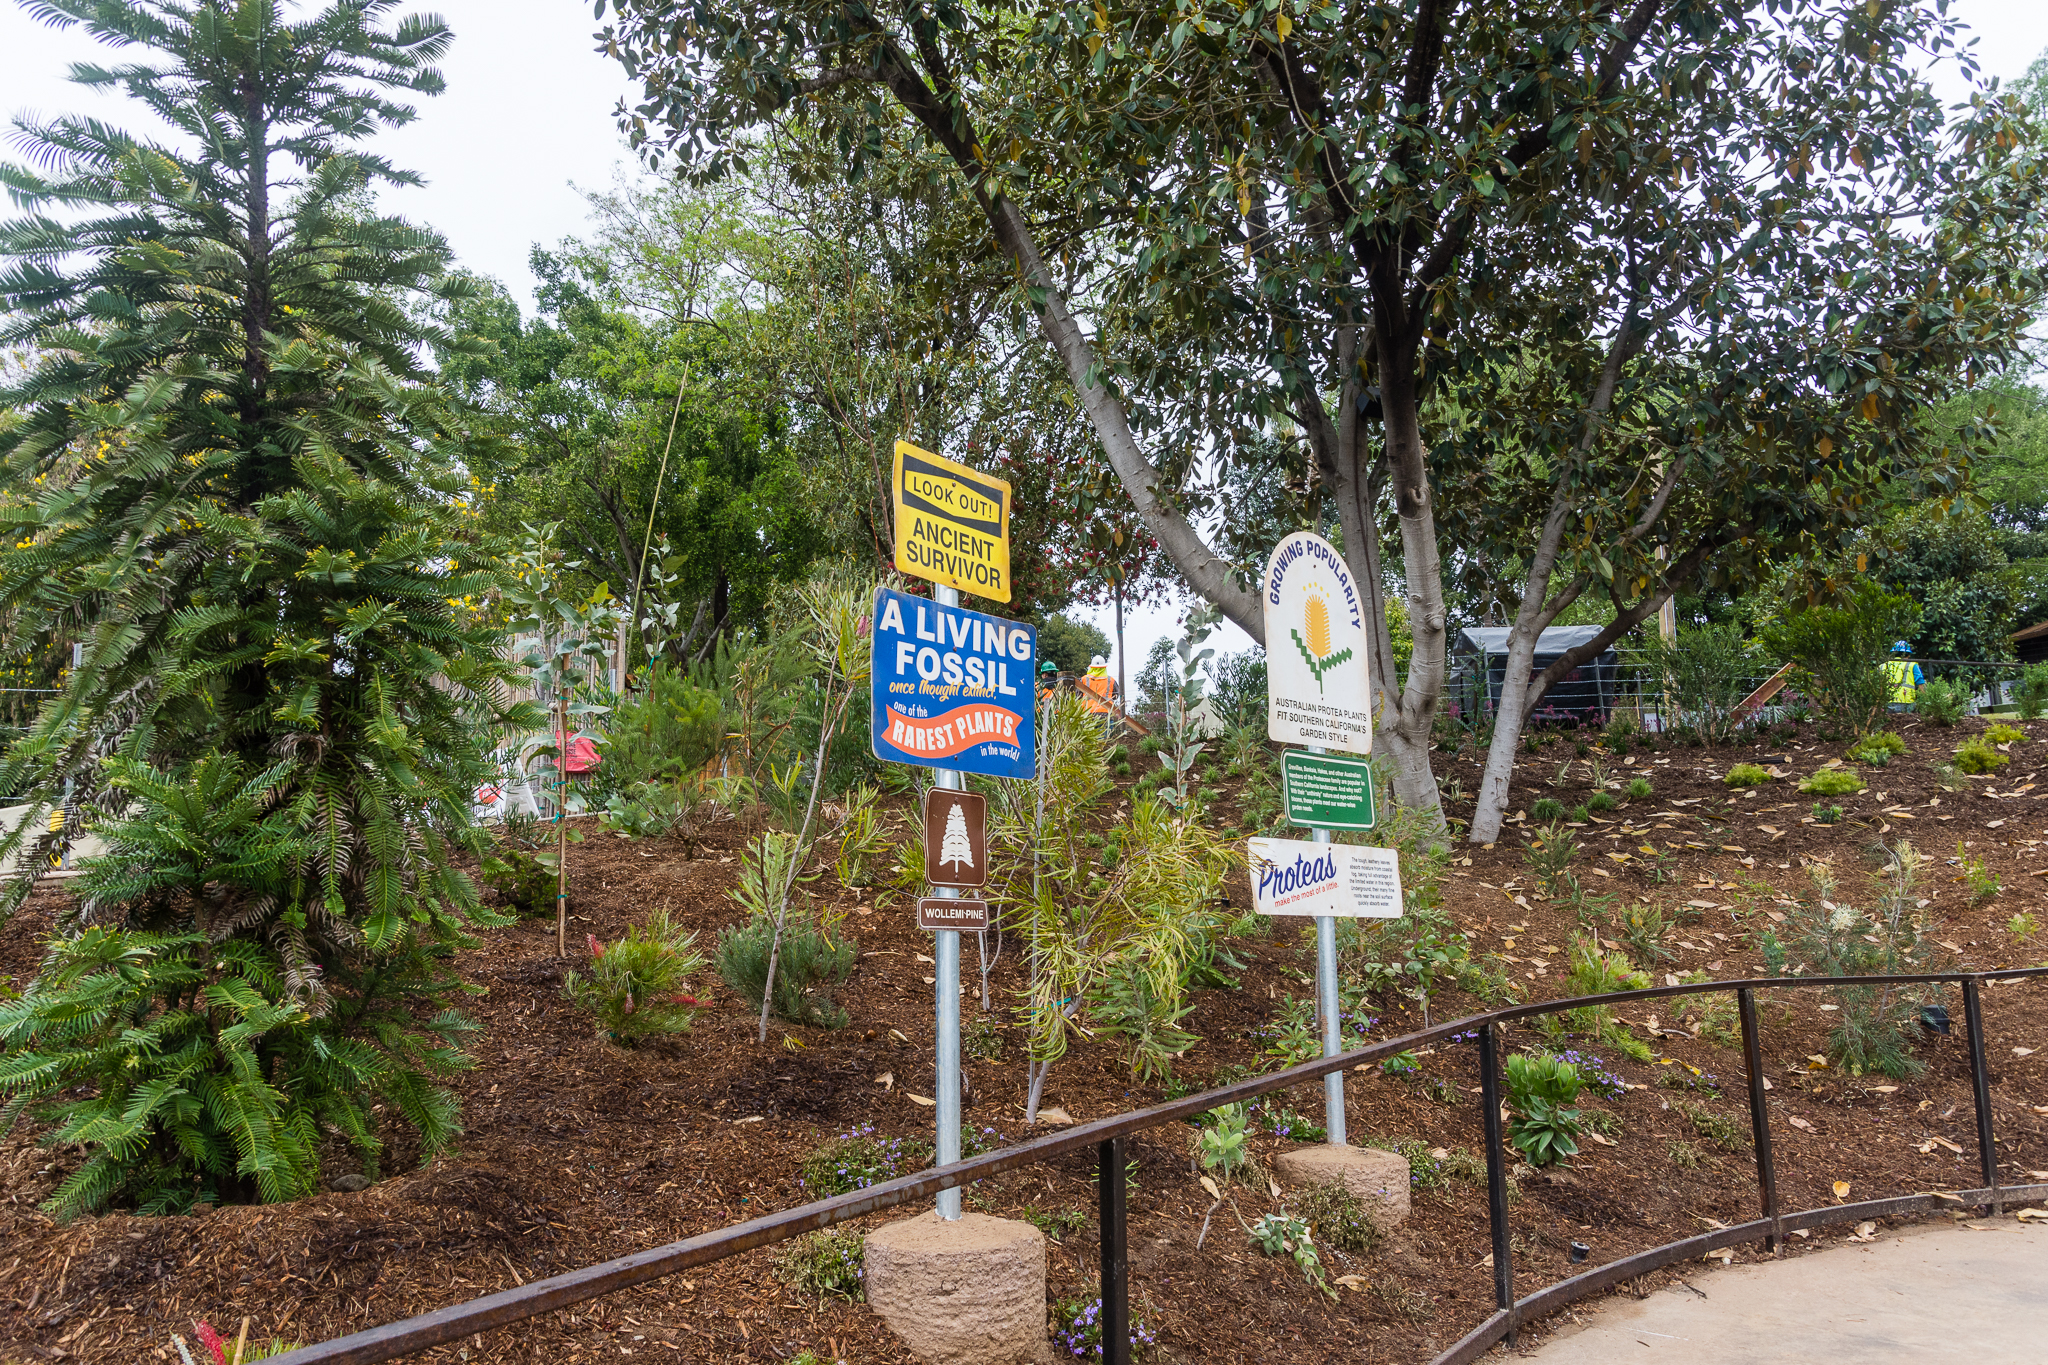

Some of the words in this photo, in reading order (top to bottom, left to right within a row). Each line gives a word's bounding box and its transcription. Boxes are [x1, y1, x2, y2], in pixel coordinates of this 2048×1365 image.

[913, 476, 954, 505] LOOK
[959, 494, 992, 518] OUT!
[913, 517, 994, 562] ANCIENT
[906, 540, 1001, 590] SURVIVOR
[1270, 540, 1304, 606] GROWING
[1306, 540, 1361, 629] POPULARITY
[879, 598, 906, 635] A
[916, 605, 1031, 661] LIVING
[896, 640, 1017, 696] FOSSIL
[889, 681, 915, 694] once
[918, 679, 964, 702] thought
[894, 701, 907, 713] one
[908, 705, 916, 717] of
[916, 704, 928, 718] the
[1275, 697, 1317, 713] AUSTRALIAN
[1318, 705, 1343, 717] PROTEA
[1344, 710, 1367, 722] PLANTS
[1277, 711, 1288, 720] FIT
[1289, 712, 1325, 727] SOUTHERN
[1325, 719, 1367, 734] CALIFORNIA'S
[892, 719, 955, 751] RAREST
[955, 711, 1013, 740] PLANTS
[1300, 727, 1327, 740] GARDEN
[1328, 732, 1348, 743] STYLE
[980, 745, 988, 757] in
[988, 743, 998, 756] the
[998, 747, 1020, 762] world!
[1259, 852, 1336, 901] Proteas
[1274, 897, 1291, 908] make
[1291, 894, 1300, 903] the
[1301, 888, 1315, 900] most
[1316, 887, 1321, 895] of
[1322, 885, 1326, 893] a
[1326, 881, 1339, 891] little.
[925, 908, 964, 919] WOLLEMI
[965, 909, 983, 919] PINE
